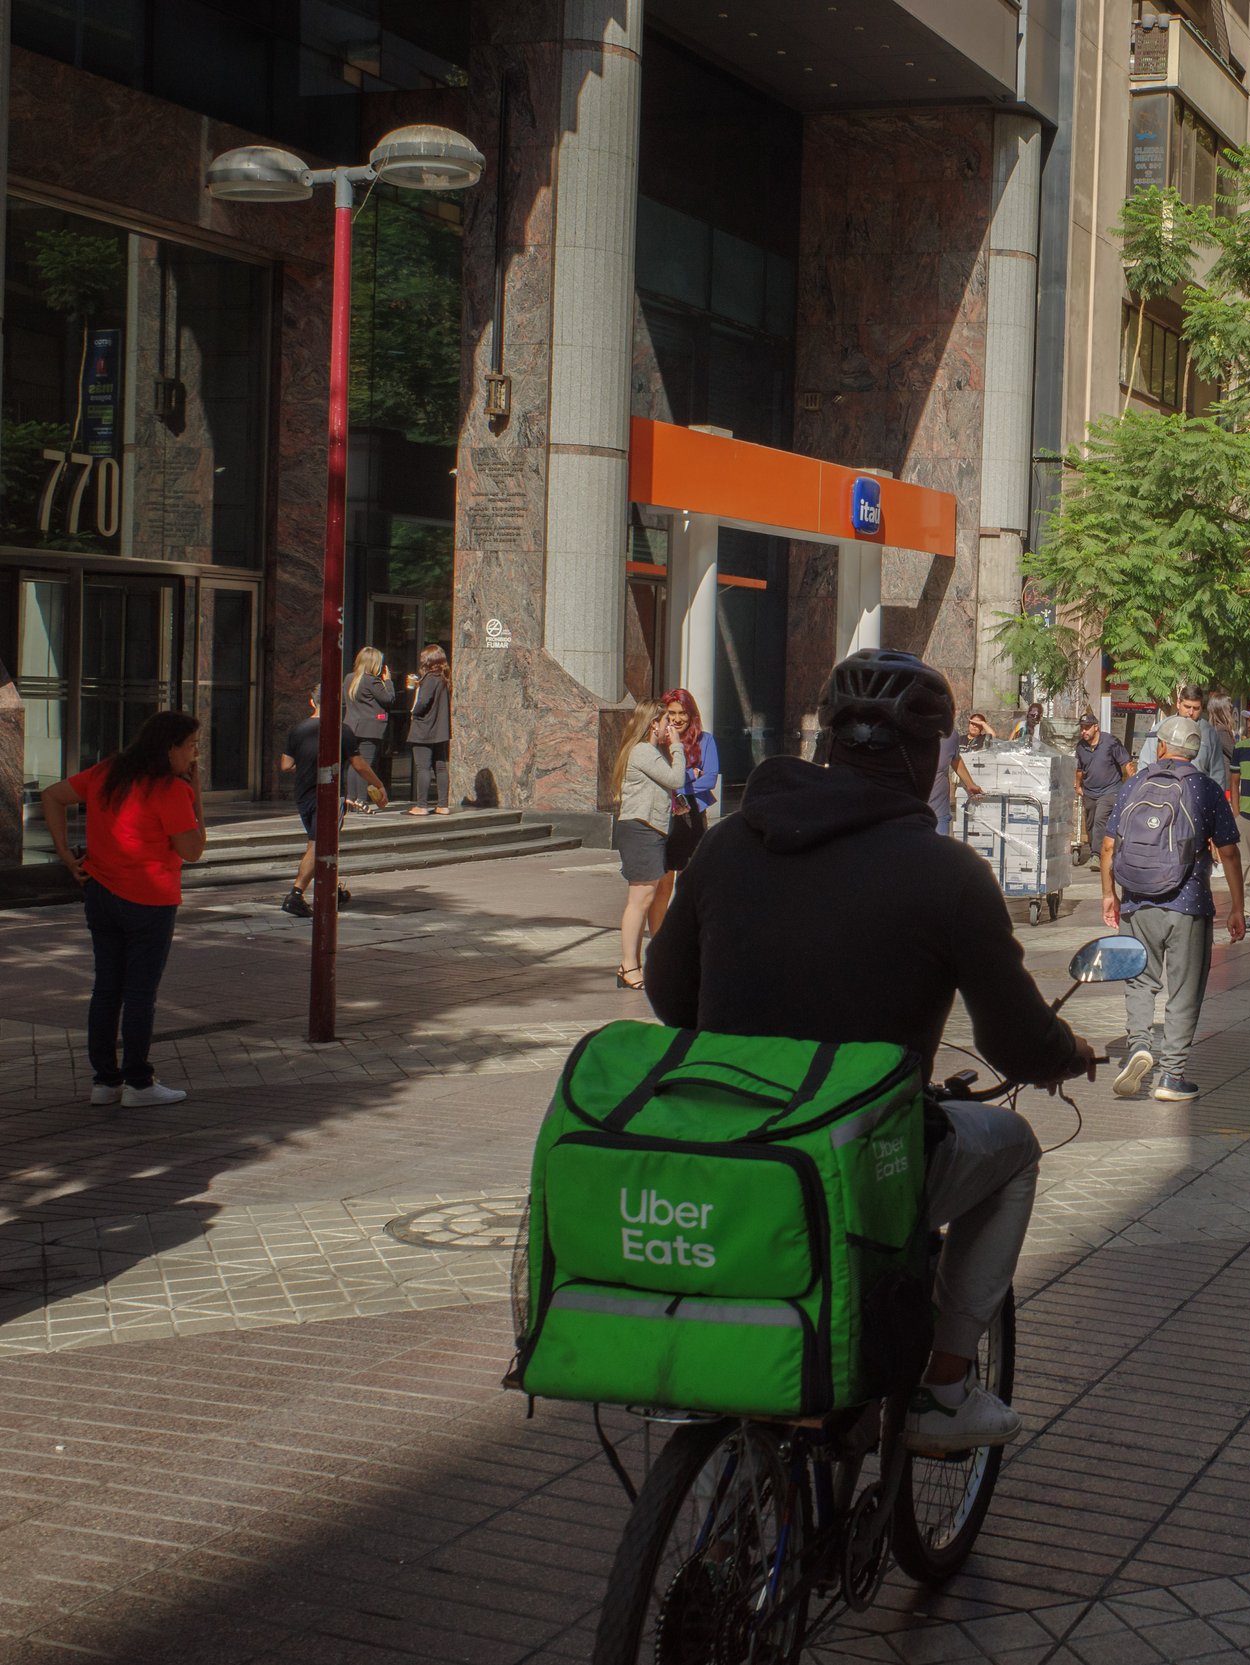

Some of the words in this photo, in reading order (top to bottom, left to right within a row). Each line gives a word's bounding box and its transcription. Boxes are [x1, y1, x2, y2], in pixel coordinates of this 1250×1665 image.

[40, 448, 120, 537] 770
[872, 1136, 904, 1160] Uber
[875, 1156, 909, 1182] Eats
[620, 1187, 714, 1229] Uber
[621, 1227, 716, 1268] Eats
